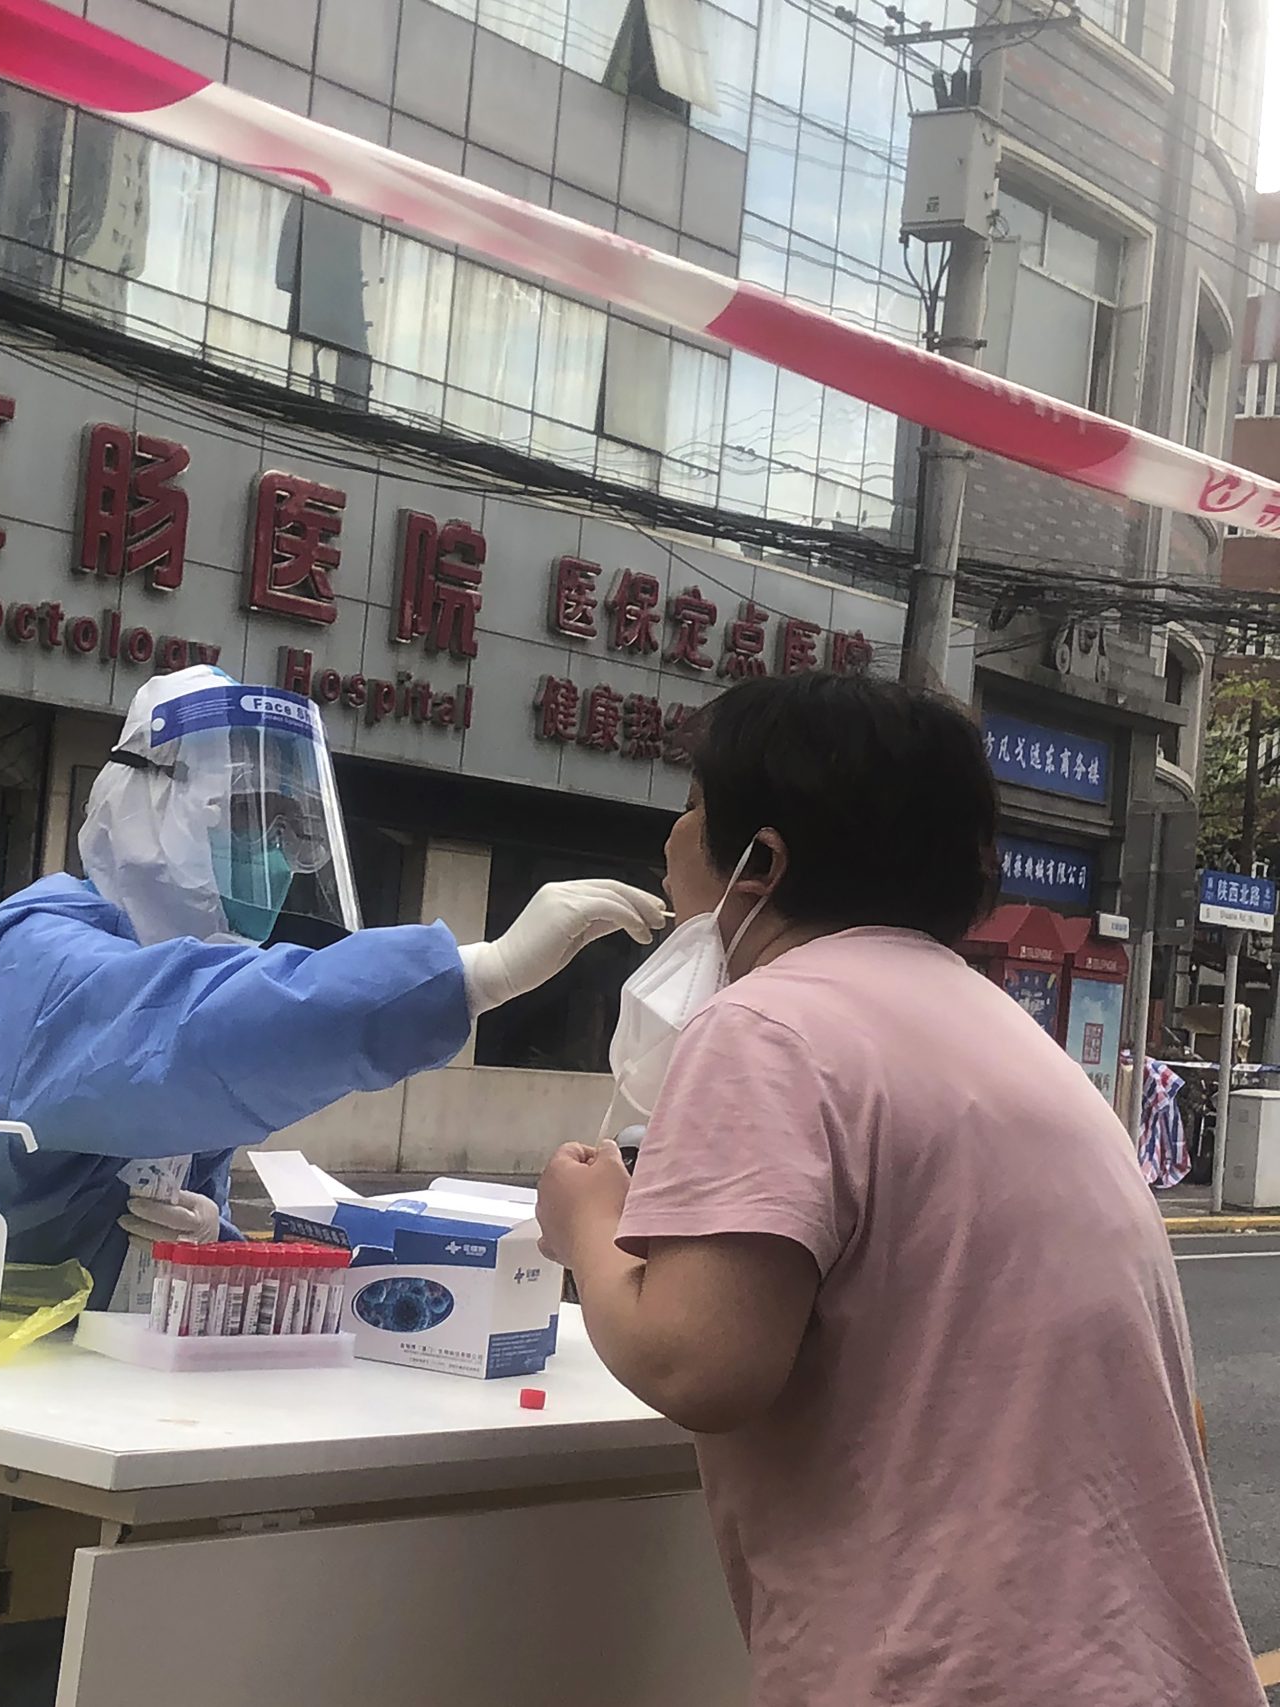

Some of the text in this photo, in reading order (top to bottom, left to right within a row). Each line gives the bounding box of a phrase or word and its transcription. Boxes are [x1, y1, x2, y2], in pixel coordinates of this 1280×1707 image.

[278, 646, 473, 730] Hospital
[252, 697, 292, 715] Face
[1217, 879, 1260, 906] 陕西北路
